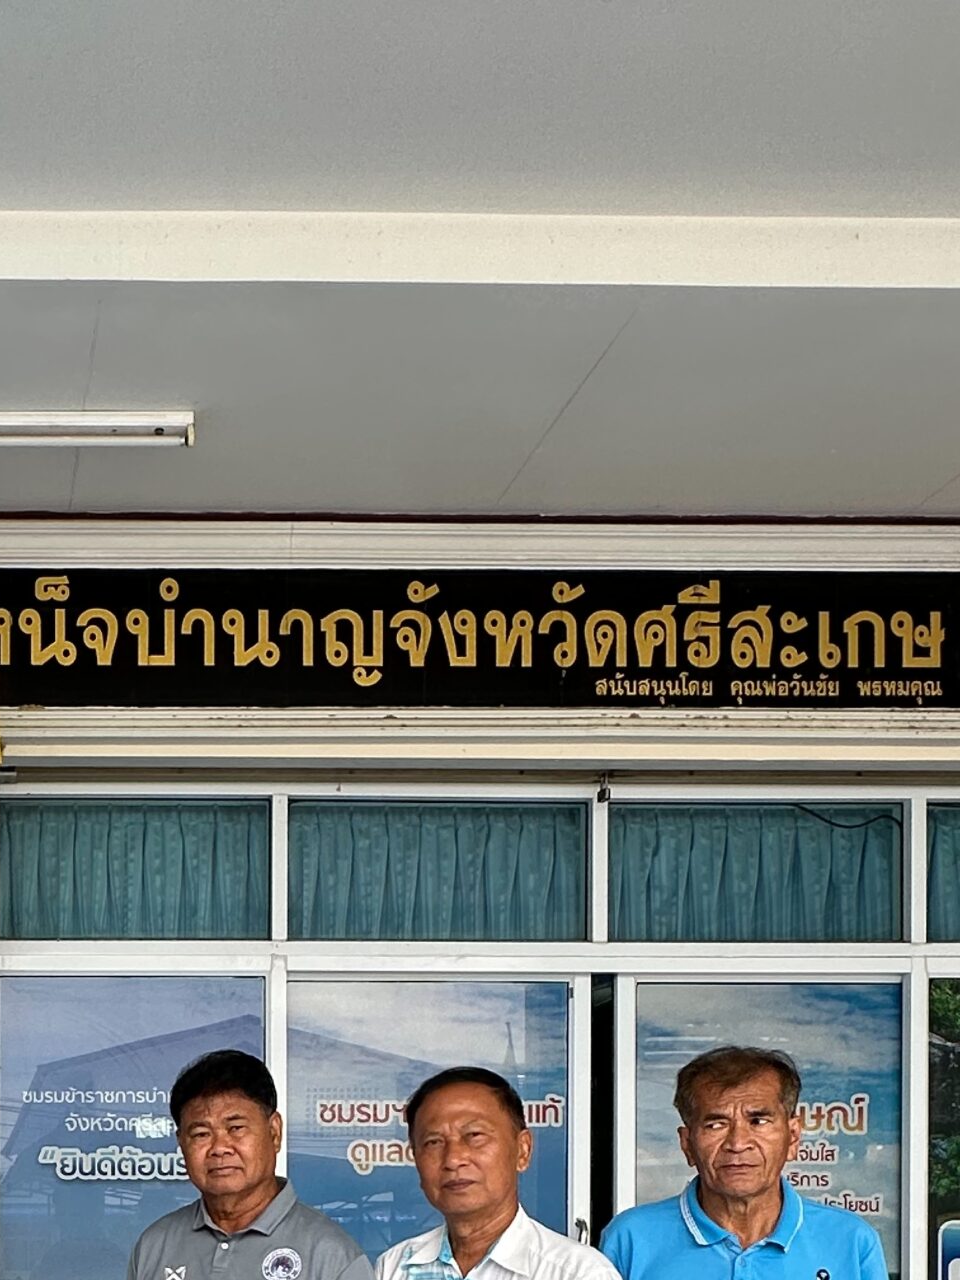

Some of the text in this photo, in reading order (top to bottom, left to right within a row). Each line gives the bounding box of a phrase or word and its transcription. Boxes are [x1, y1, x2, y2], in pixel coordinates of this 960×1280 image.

[595, 672, 943, 705] สนับสนุนโดย คุณพ่อวันชัย พรหมคุณ
